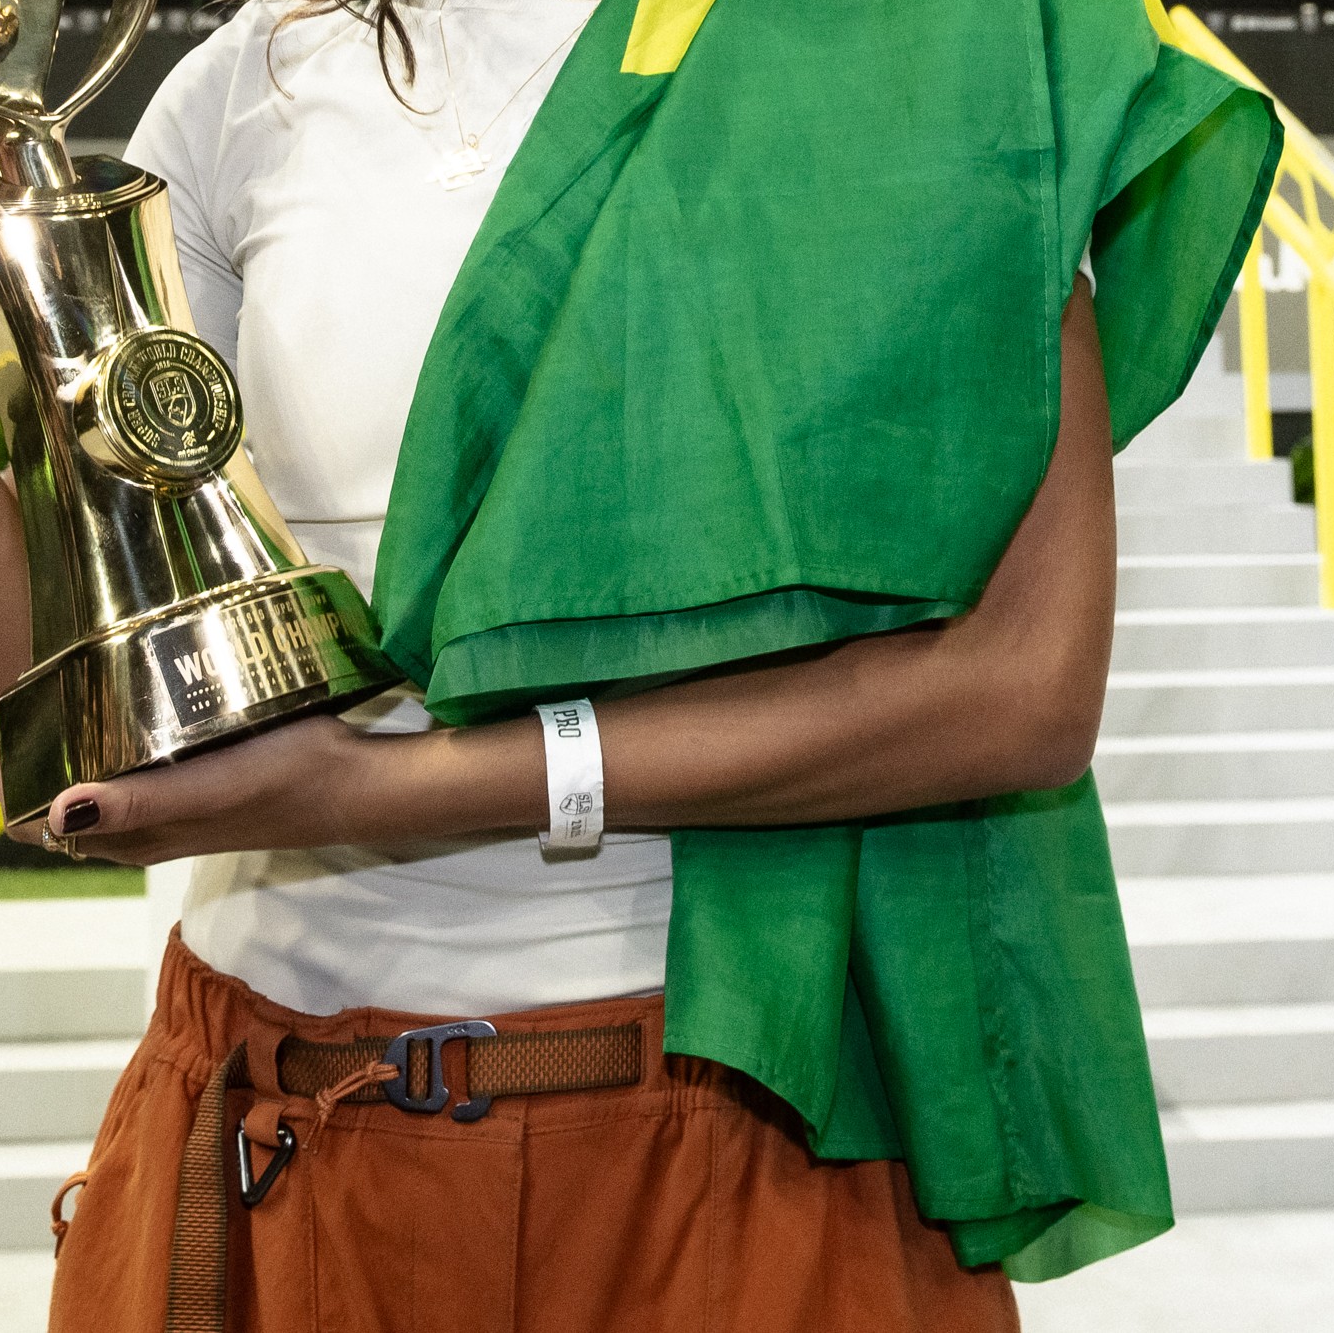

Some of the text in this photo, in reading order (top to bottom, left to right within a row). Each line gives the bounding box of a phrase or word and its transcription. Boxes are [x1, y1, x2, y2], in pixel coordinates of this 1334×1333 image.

[137, 343, 176, 364] WORLD
[122, 361, 144, 407] CROWN
[155, 376, 187, 399] SLS
[127, 408, 161, 448] SUPER
[553, 709, 581, 739] PRO
[578, 794, 591, 814] SLS
